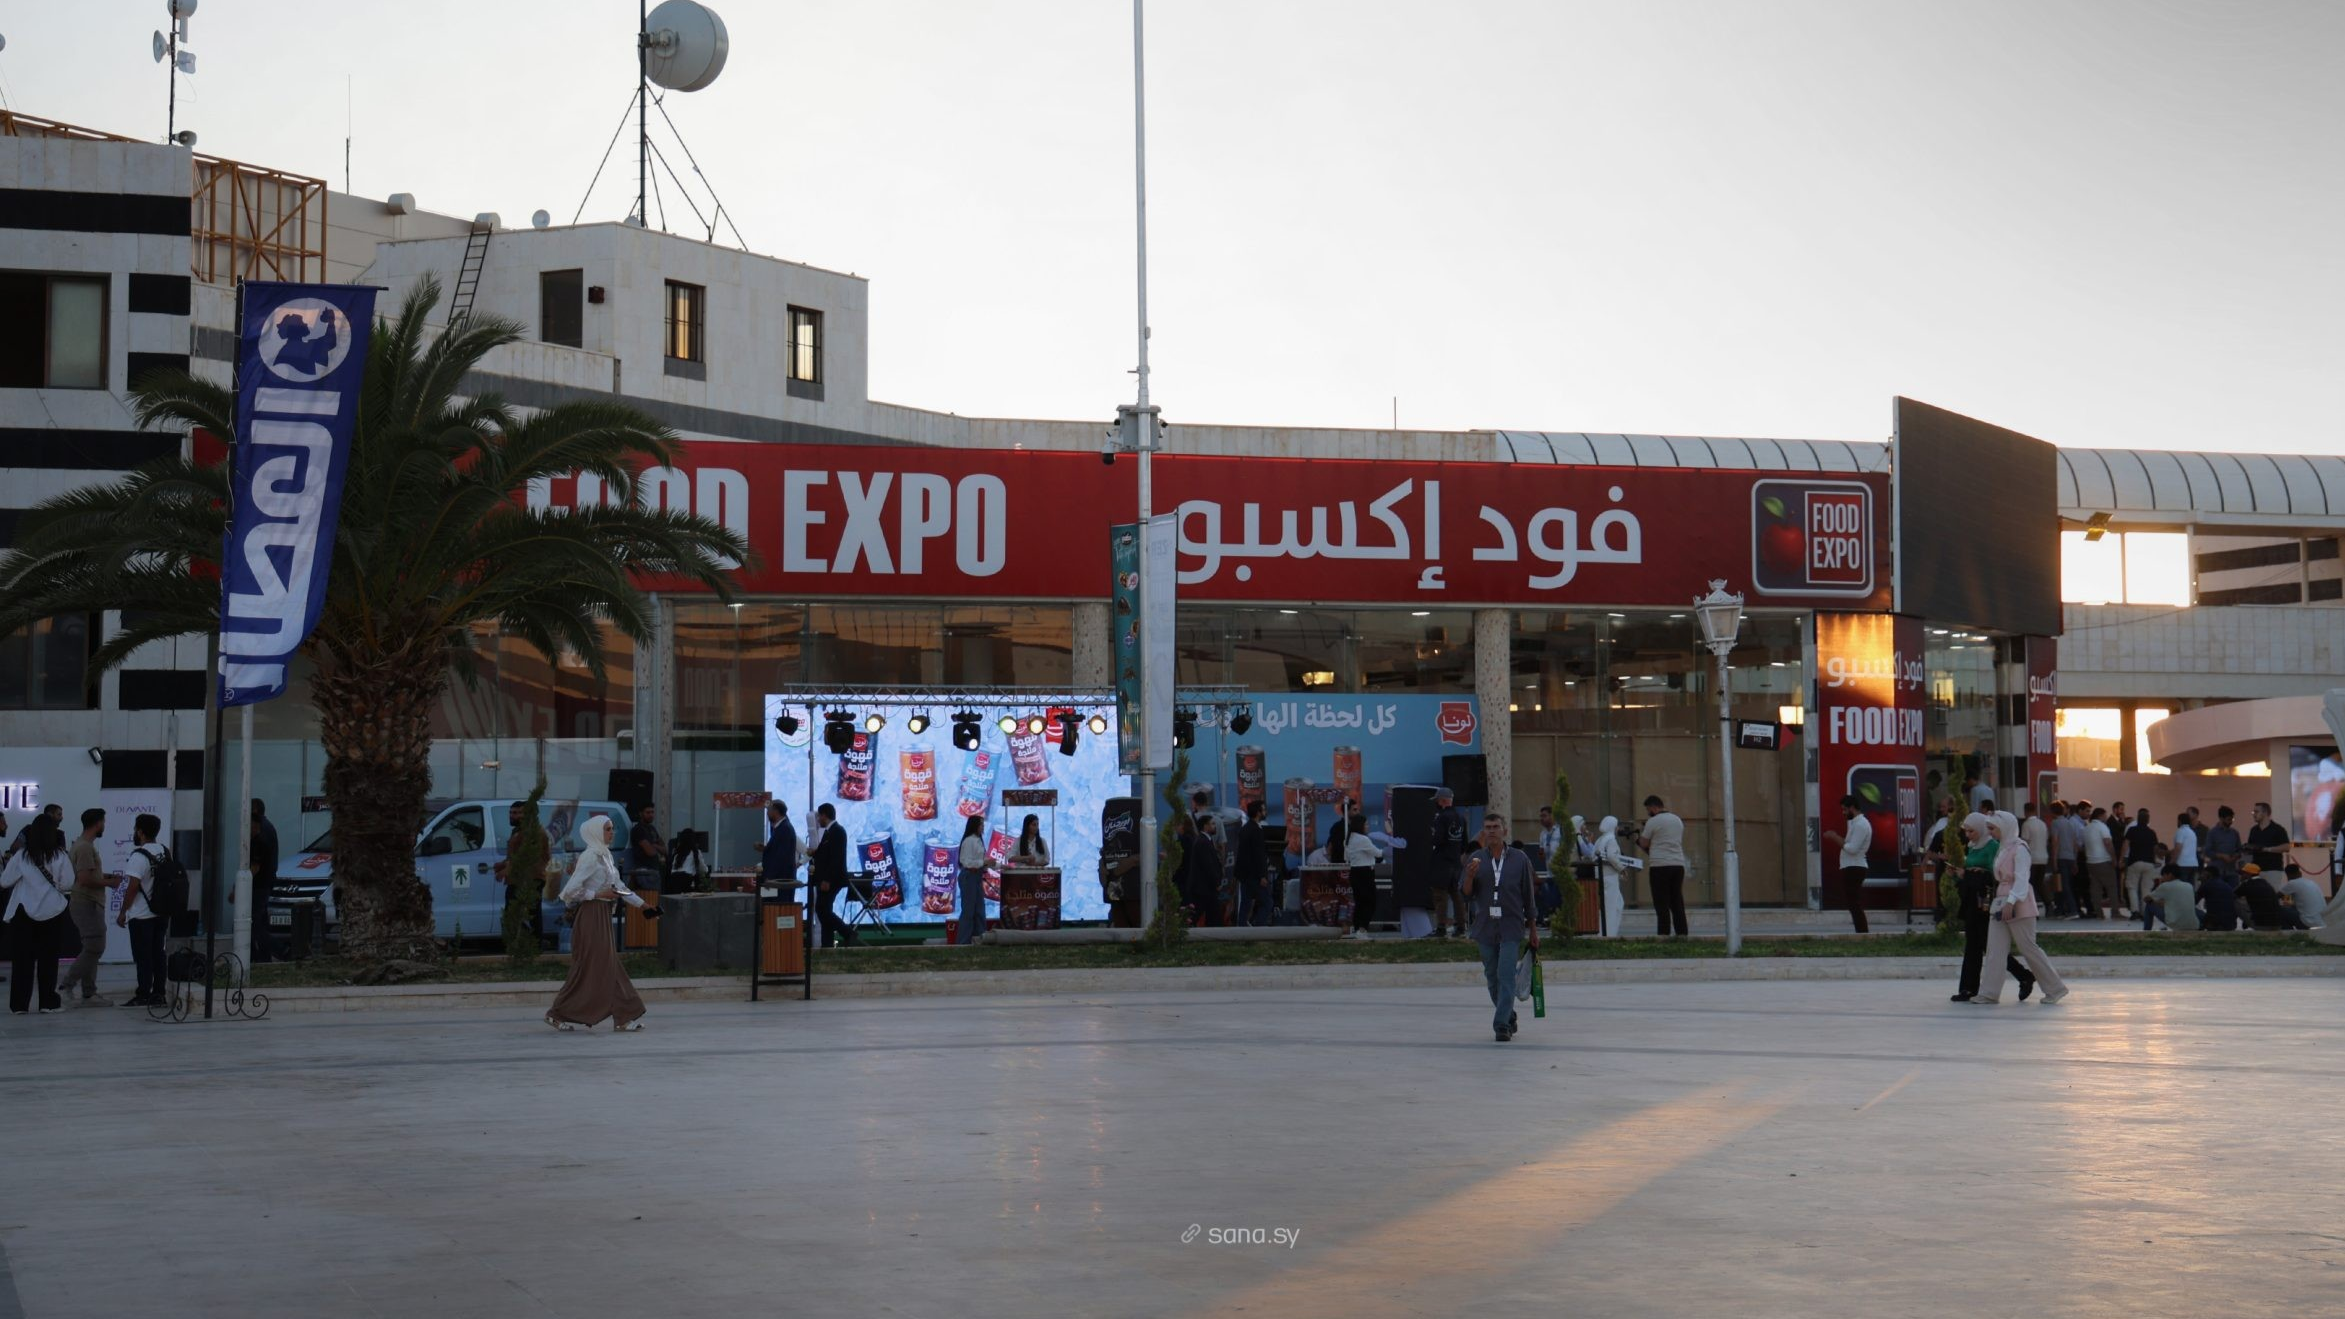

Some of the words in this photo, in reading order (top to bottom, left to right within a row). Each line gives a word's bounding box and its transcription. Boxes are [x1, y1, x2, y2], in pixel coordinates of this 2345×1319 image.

[783, 470, 1007, 577] EXPO
[1177, 478, 1445, 590] إكسبو
[1811, 502, 1860, 535] FOOD
[1472, 485, 1642, 591] فود
[1812, 537, 1861, 571] EXPO
[1827, 651, 1902, 690] إكسبو
[1904, 654, 1923, 690] فود
[1257, 702, 1298, 735] الها
[1304, 702, 1363, 728] لحظة
[1368, 704, 1397, 735] كل
[1443, 714, 1472, 734] لونا
[1829, 706, 1897, 745] FOOD
[1899, 708, 1923, 747] EXPO
[2031, 720, 2052, 754] FOOD
[1899, 788, 1915, 819] FOOD
[864, 855, 893, 872] قهوة
[926, 862, 954, 877] قهوة
